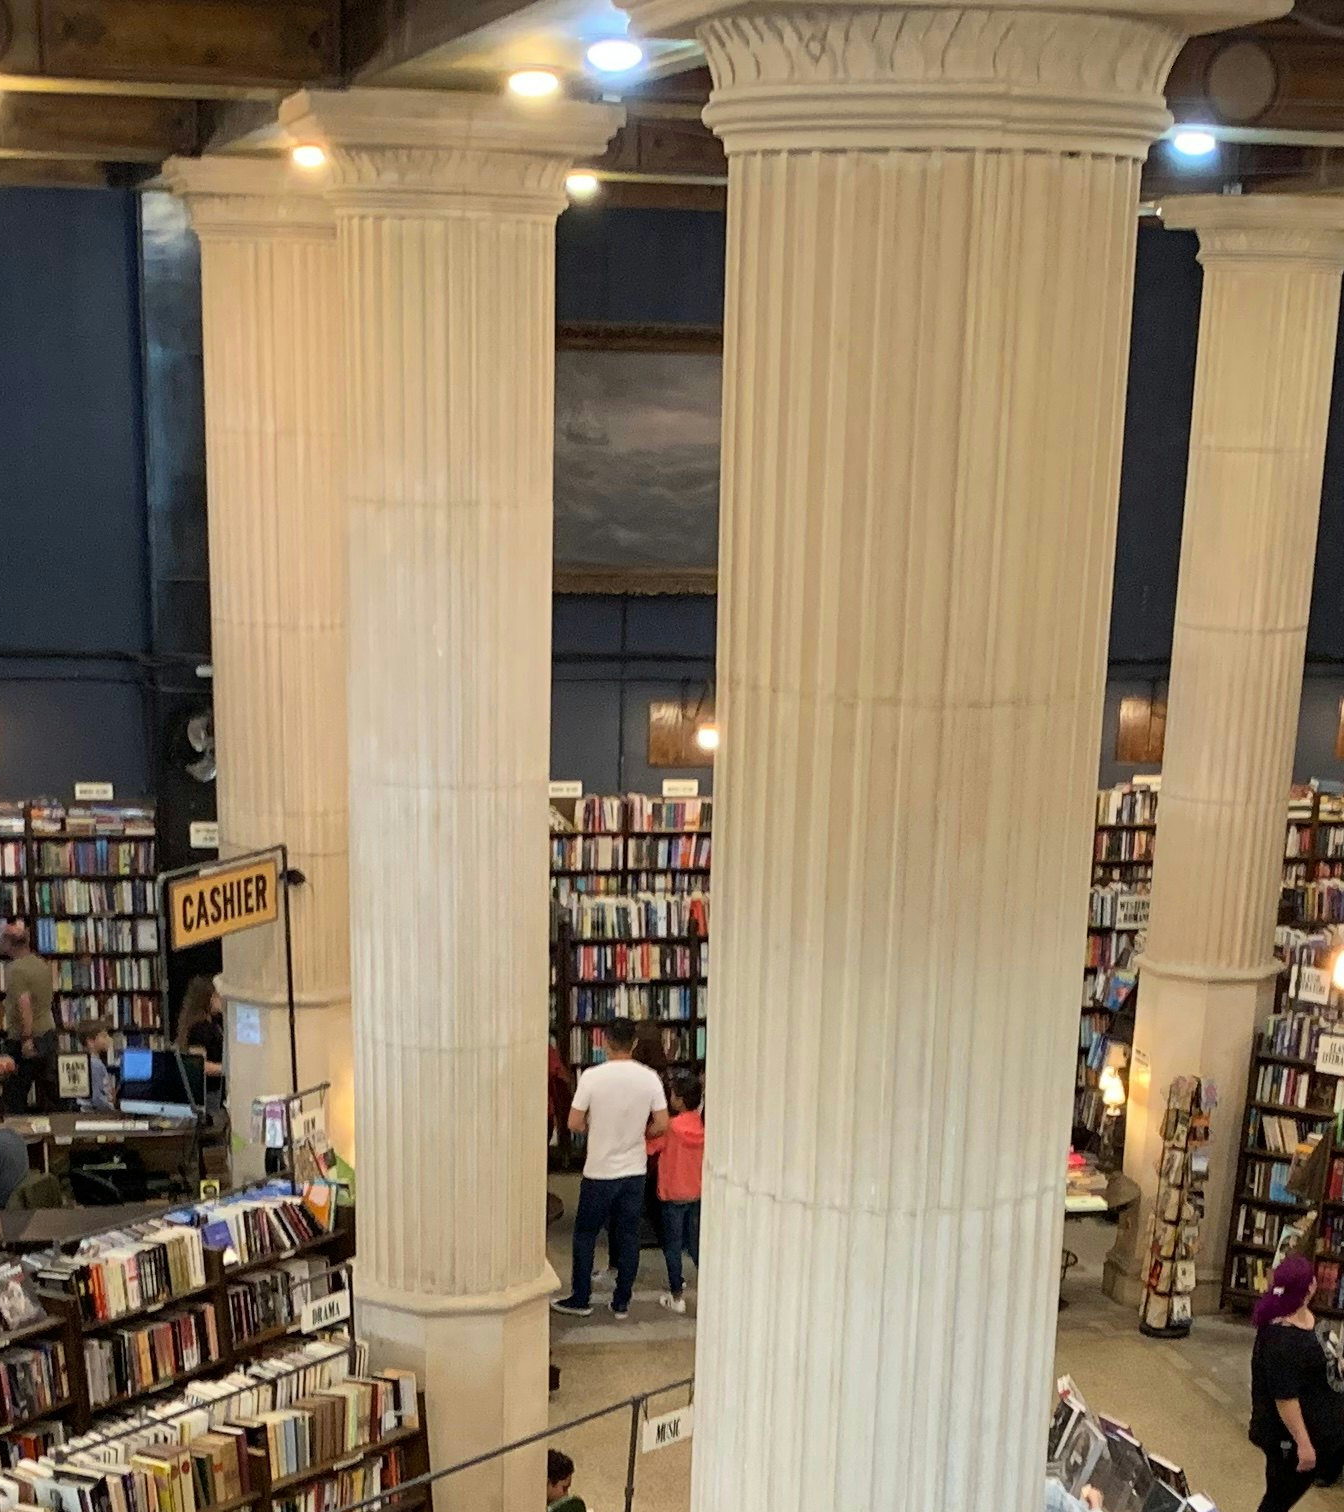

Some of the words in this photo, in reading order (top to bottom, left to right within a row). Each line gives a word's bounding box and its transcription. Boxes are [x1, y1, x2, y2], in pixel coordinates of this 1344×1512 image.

[182, 874, 267, 932] CASHIER
[312, 1301, 340, 1325] DRAMA
[655, 1418, 681, 1444] MUSIC
